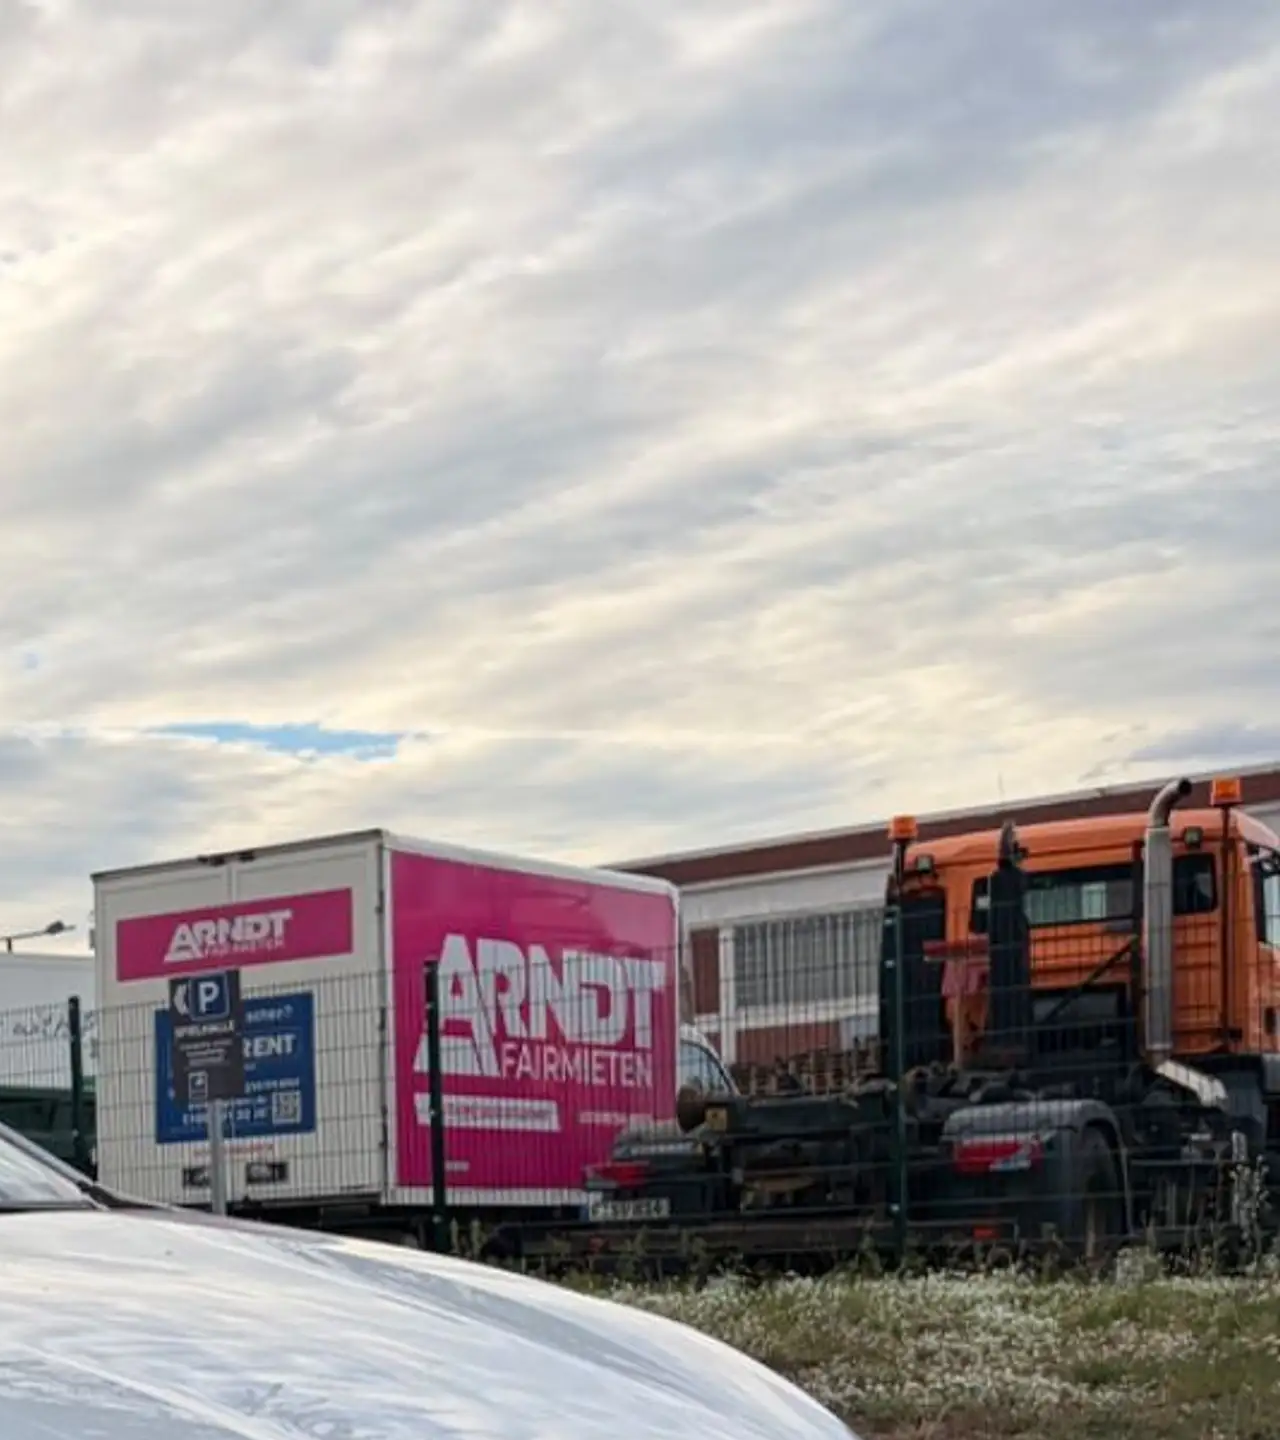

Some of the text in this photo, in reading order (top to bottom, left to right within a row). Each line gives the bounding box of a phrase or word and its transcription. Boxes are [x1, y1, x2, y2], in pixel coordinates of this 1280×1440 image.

[163, 908, 294, 964] ARNDT
[198, 981, 221, 1014] P
[413, 933, 666, 1077] ARNDT
[500, 1043, 653, 1088] FAIRMIETEN
